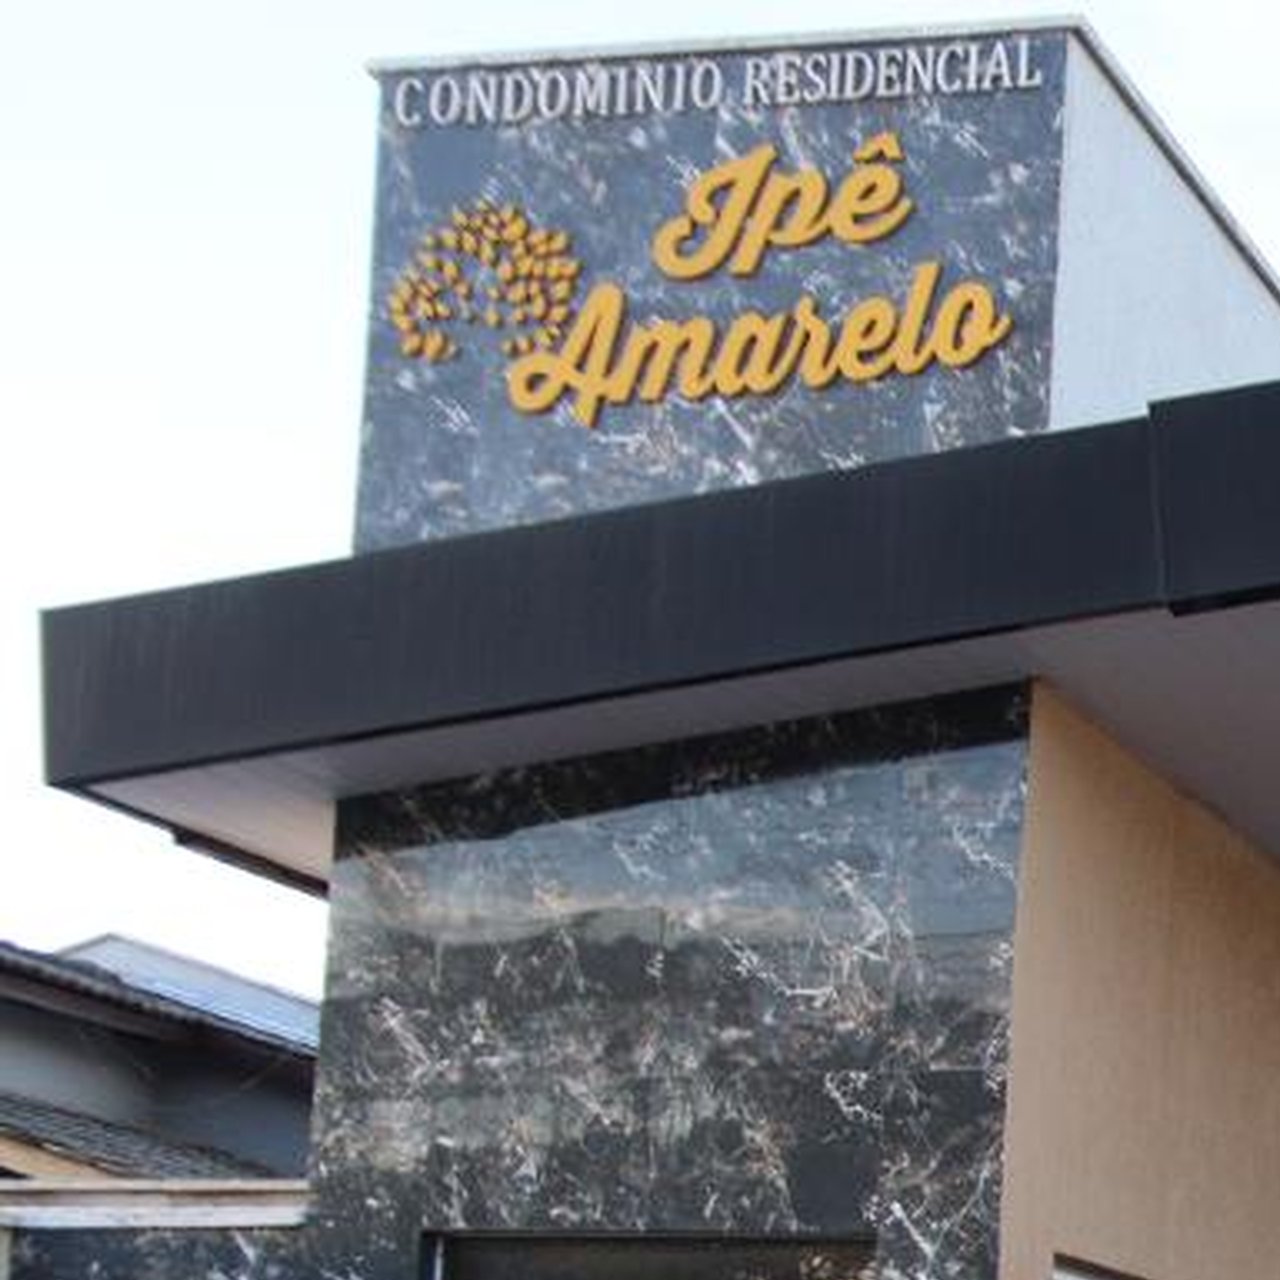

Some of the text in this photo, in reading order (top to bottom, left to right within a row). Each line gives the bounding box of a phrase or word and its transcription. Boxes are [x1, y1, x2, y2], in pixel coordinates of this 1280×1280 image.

[396, 40, 1043, 126] CONDOMINIO RESIDENCIAL
[652, 133, 917, 280] Ipê
[508, 262, 1012, 428] Amarelo
